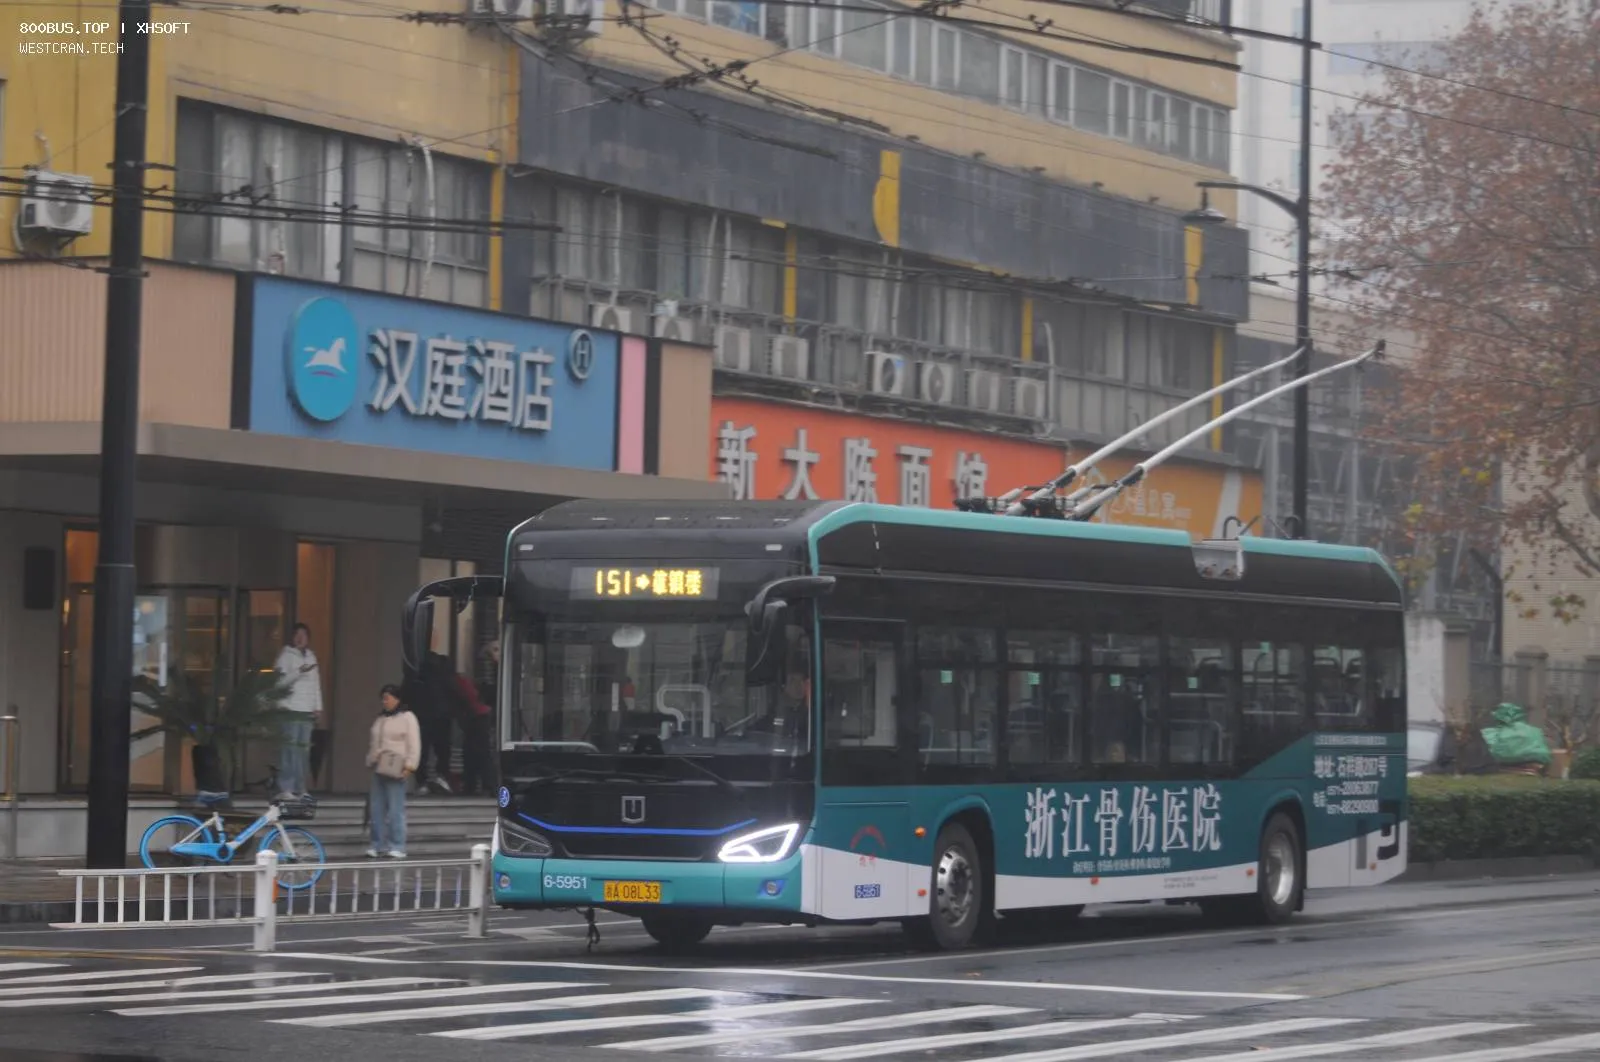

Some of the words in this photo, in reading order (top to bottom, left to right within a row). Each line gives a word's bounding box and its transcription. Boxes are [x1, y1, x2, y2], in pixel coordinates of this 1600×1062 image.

[367, 327, 556, 431] 汉庭酒店
[717, 421, 988, 507] 新大陈面馆
[596, 569, 631, 595] 151
[1024, 783, 1222, 859] 浙江骨伤医院
[543, 874, 588, 889] 6-5951
[623, 882, 660, 900] 08L33
